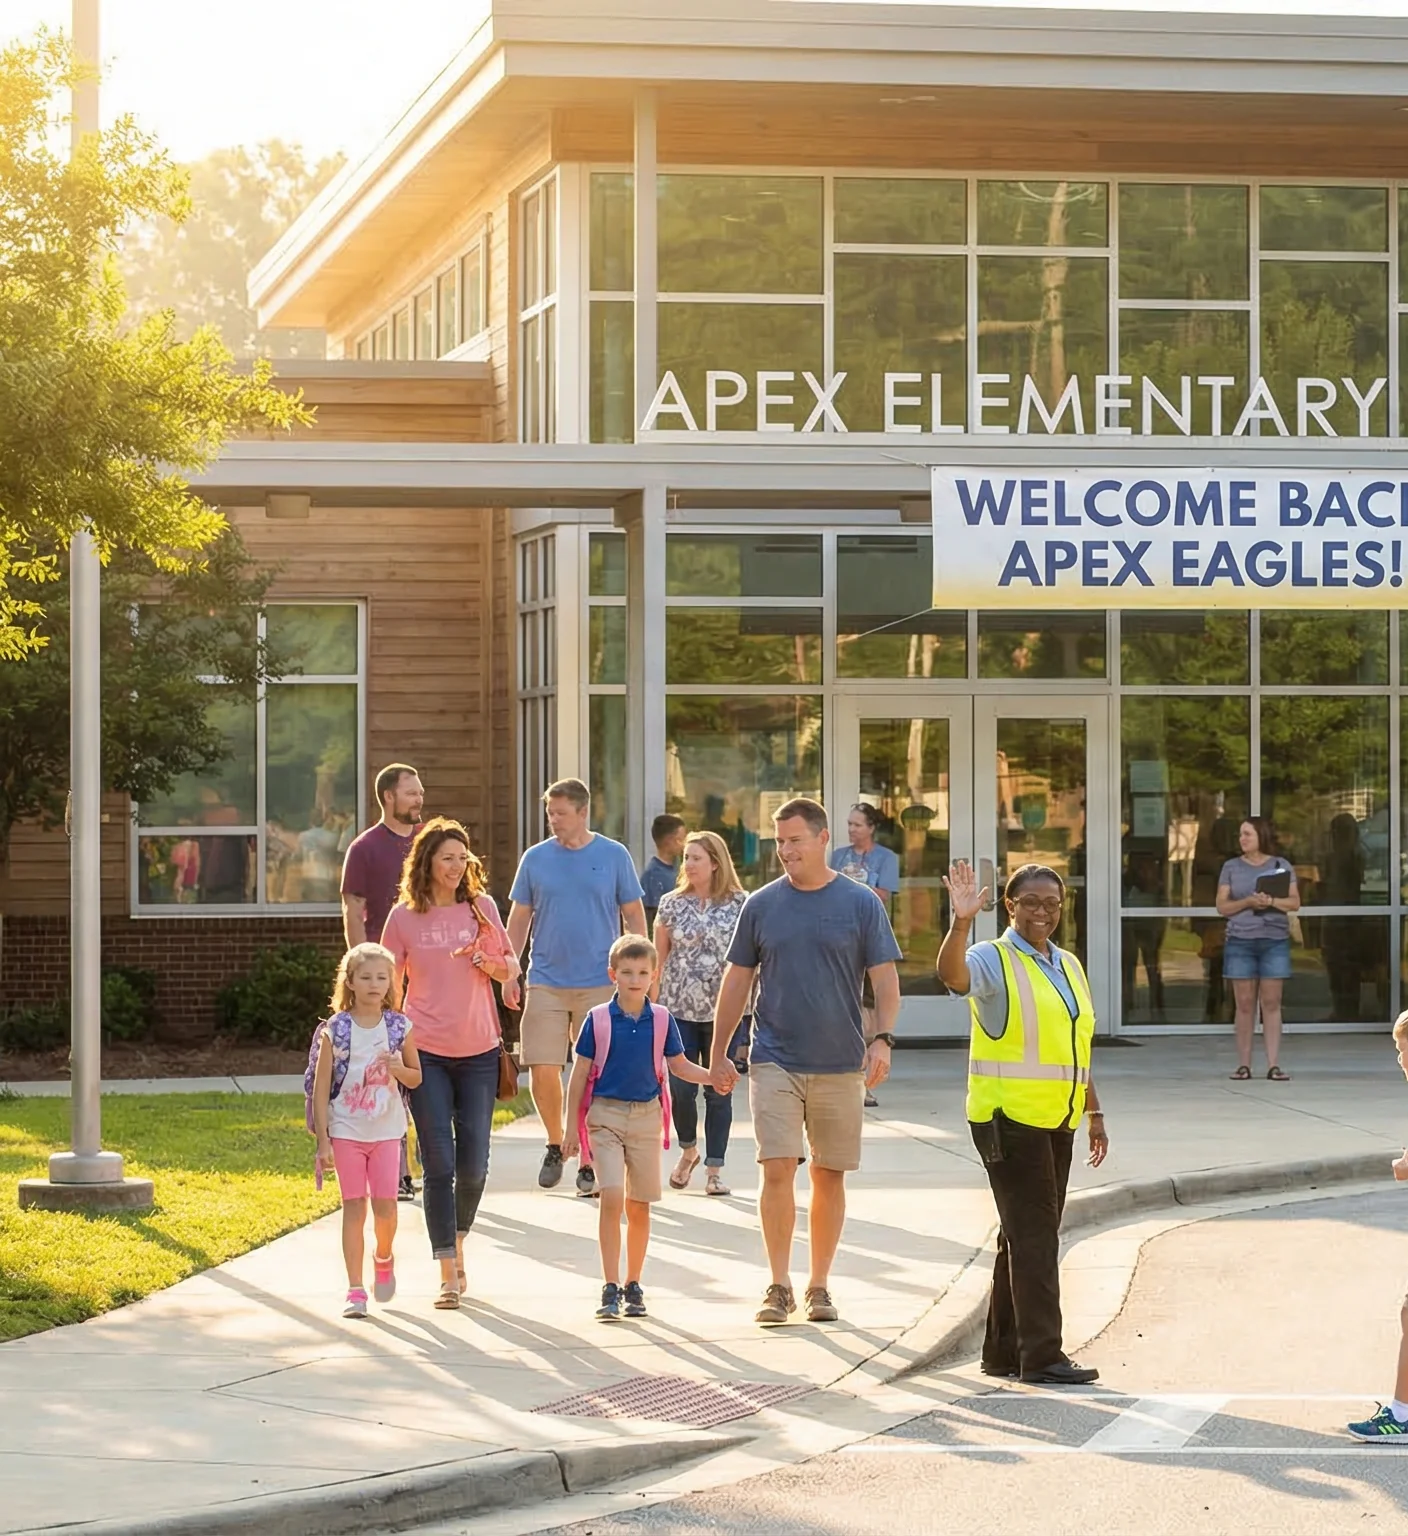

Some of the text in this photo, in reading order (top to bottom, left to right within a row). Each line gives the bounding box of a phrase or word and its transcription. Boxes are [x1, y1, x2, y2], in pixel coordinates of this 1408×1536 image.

[641, 370, 849, 433] APEX
[884, 371, 1388, 437] ELEMENTARY
[954, 479, 1258, 528] WELCOME
[999, 539, 1403, 587] APEX EAGLES!
